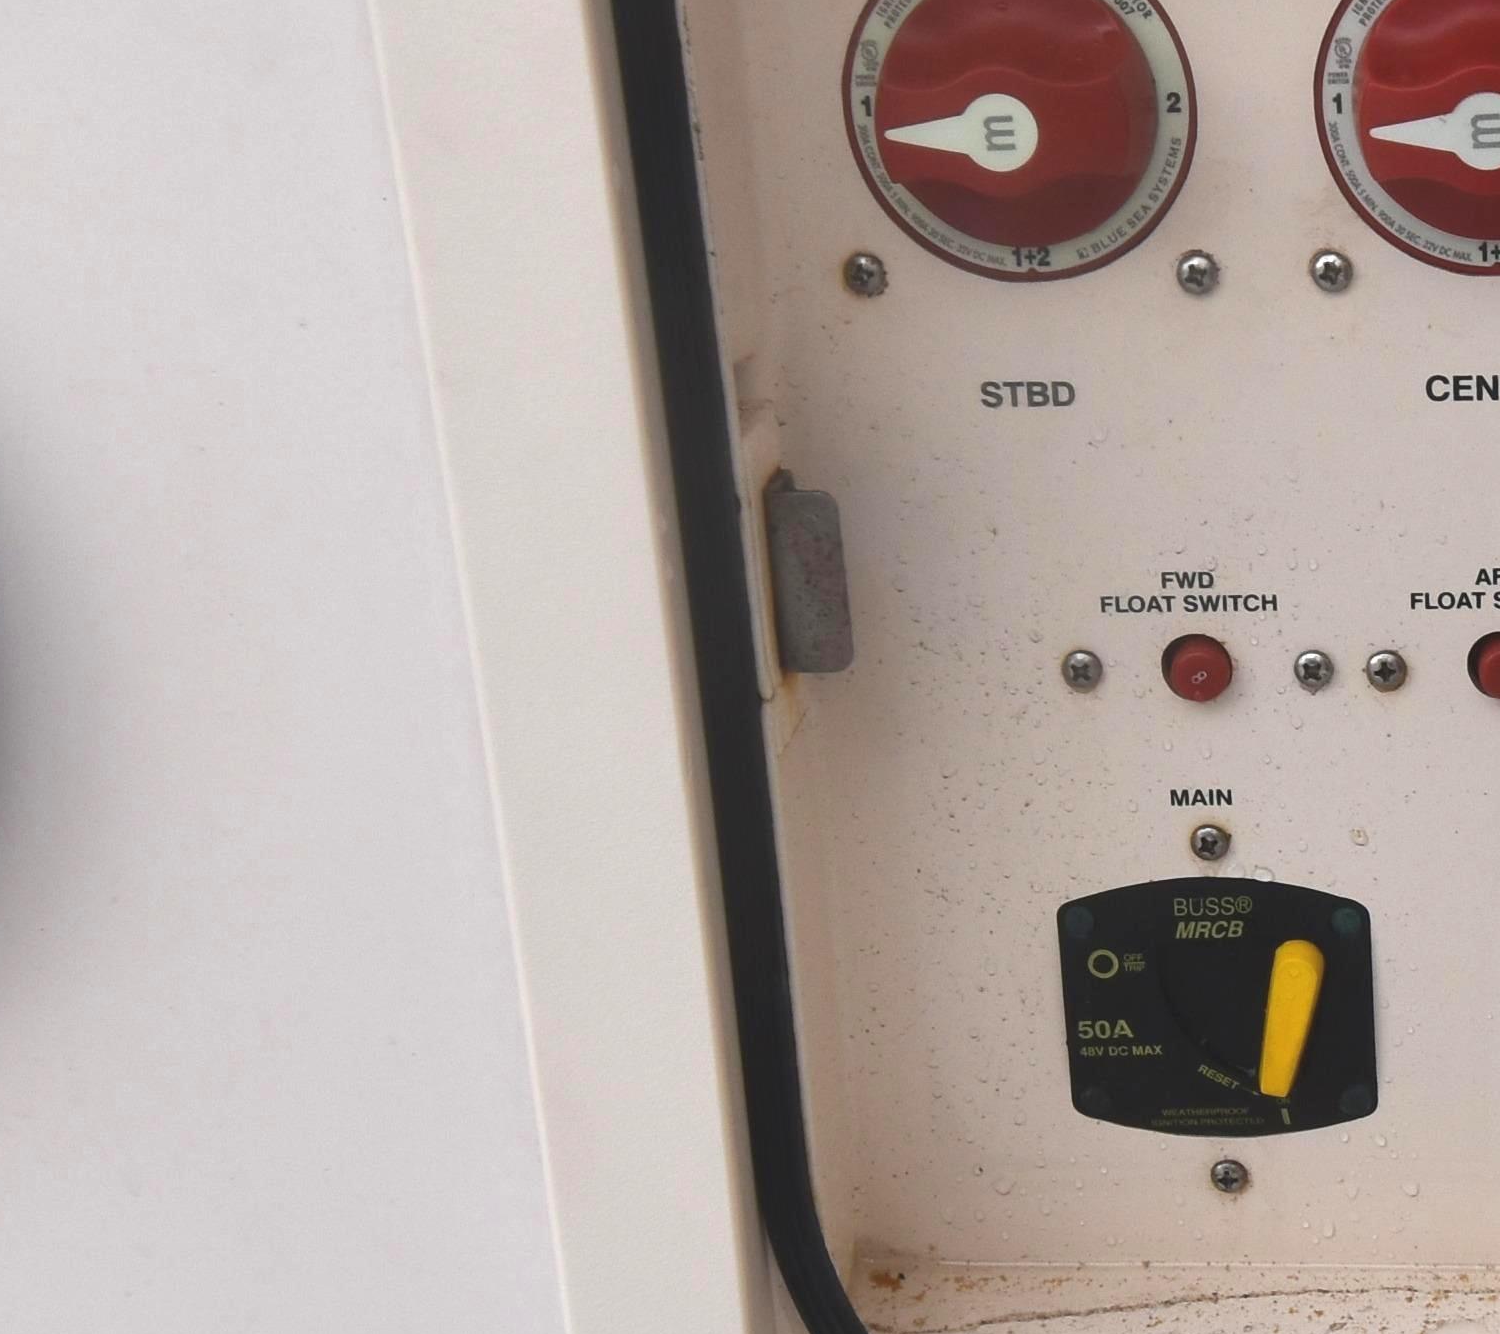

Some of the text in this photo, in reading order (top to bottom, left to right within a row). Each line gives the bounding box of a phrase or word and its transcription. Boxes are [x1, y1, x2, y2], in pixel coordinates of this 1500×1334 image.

[861, 95, 873, 117] 1
[1166, 92, 1182, 113] 2
[1332, 93, 1343, 114] 1
[1091, 137, 1182, 254] BLUE SEA SYSTEMS
[1011, 247, 1051, 267] 1+2
[979, 379, 1076, 409] STBD
[1161, 571, 1214, 590] FWD
[1100, 594, 1278, 614] FLOAT SWITCH
[1410, 591, 1484, 610] FLOAT
[1169, 788, 1233, 807] MAIN
[1175, 920, 1243, 939] MRCB
[1077, 1020, 1134, 1039] 50A
[1080, 1044, 1163, 1057] 48V DC MAX
[1198, 1064, 1240, 1090] RESET
